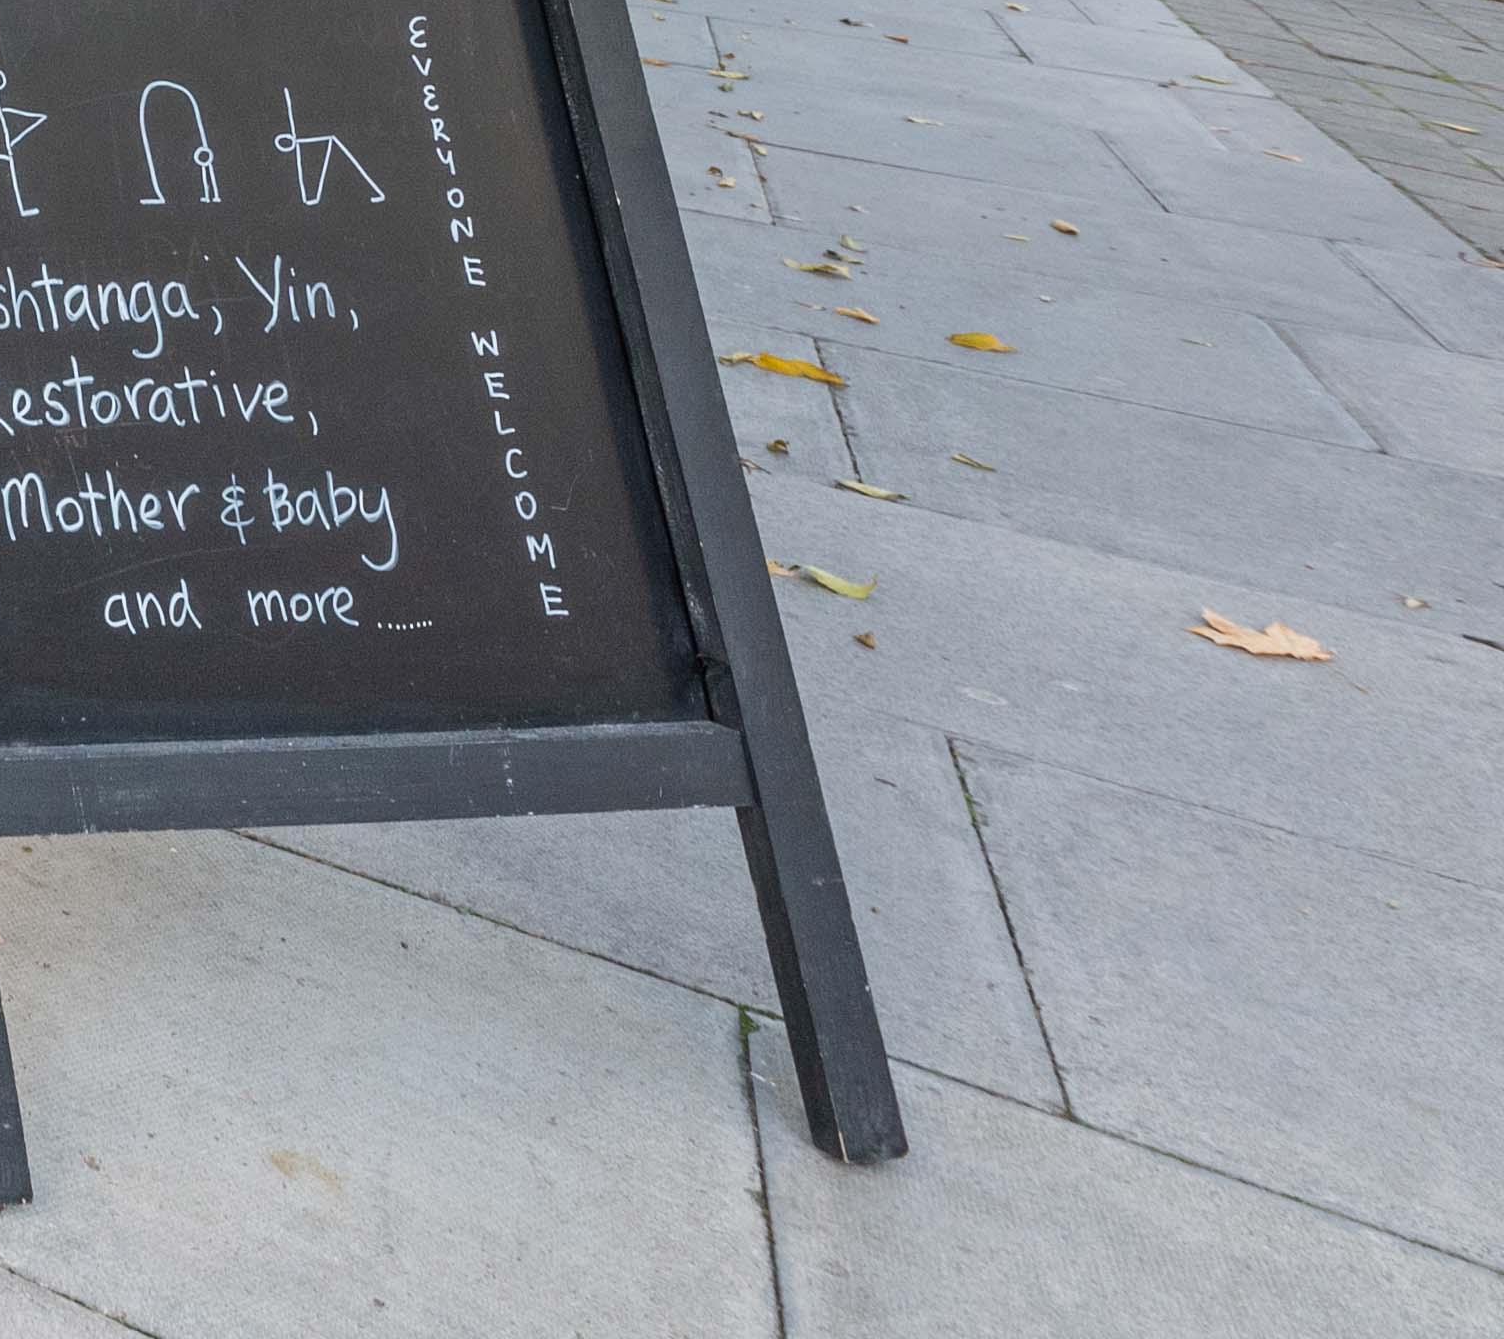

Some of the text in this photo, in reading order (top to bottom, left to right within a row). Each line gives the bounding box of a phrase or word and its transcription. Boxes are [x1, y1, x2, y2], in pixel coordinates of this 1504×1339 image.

[235, 254, 359, 334] Yin,
[0, 468, 398, 572] Mother & Baby
[104, 578, 202, 635] and
